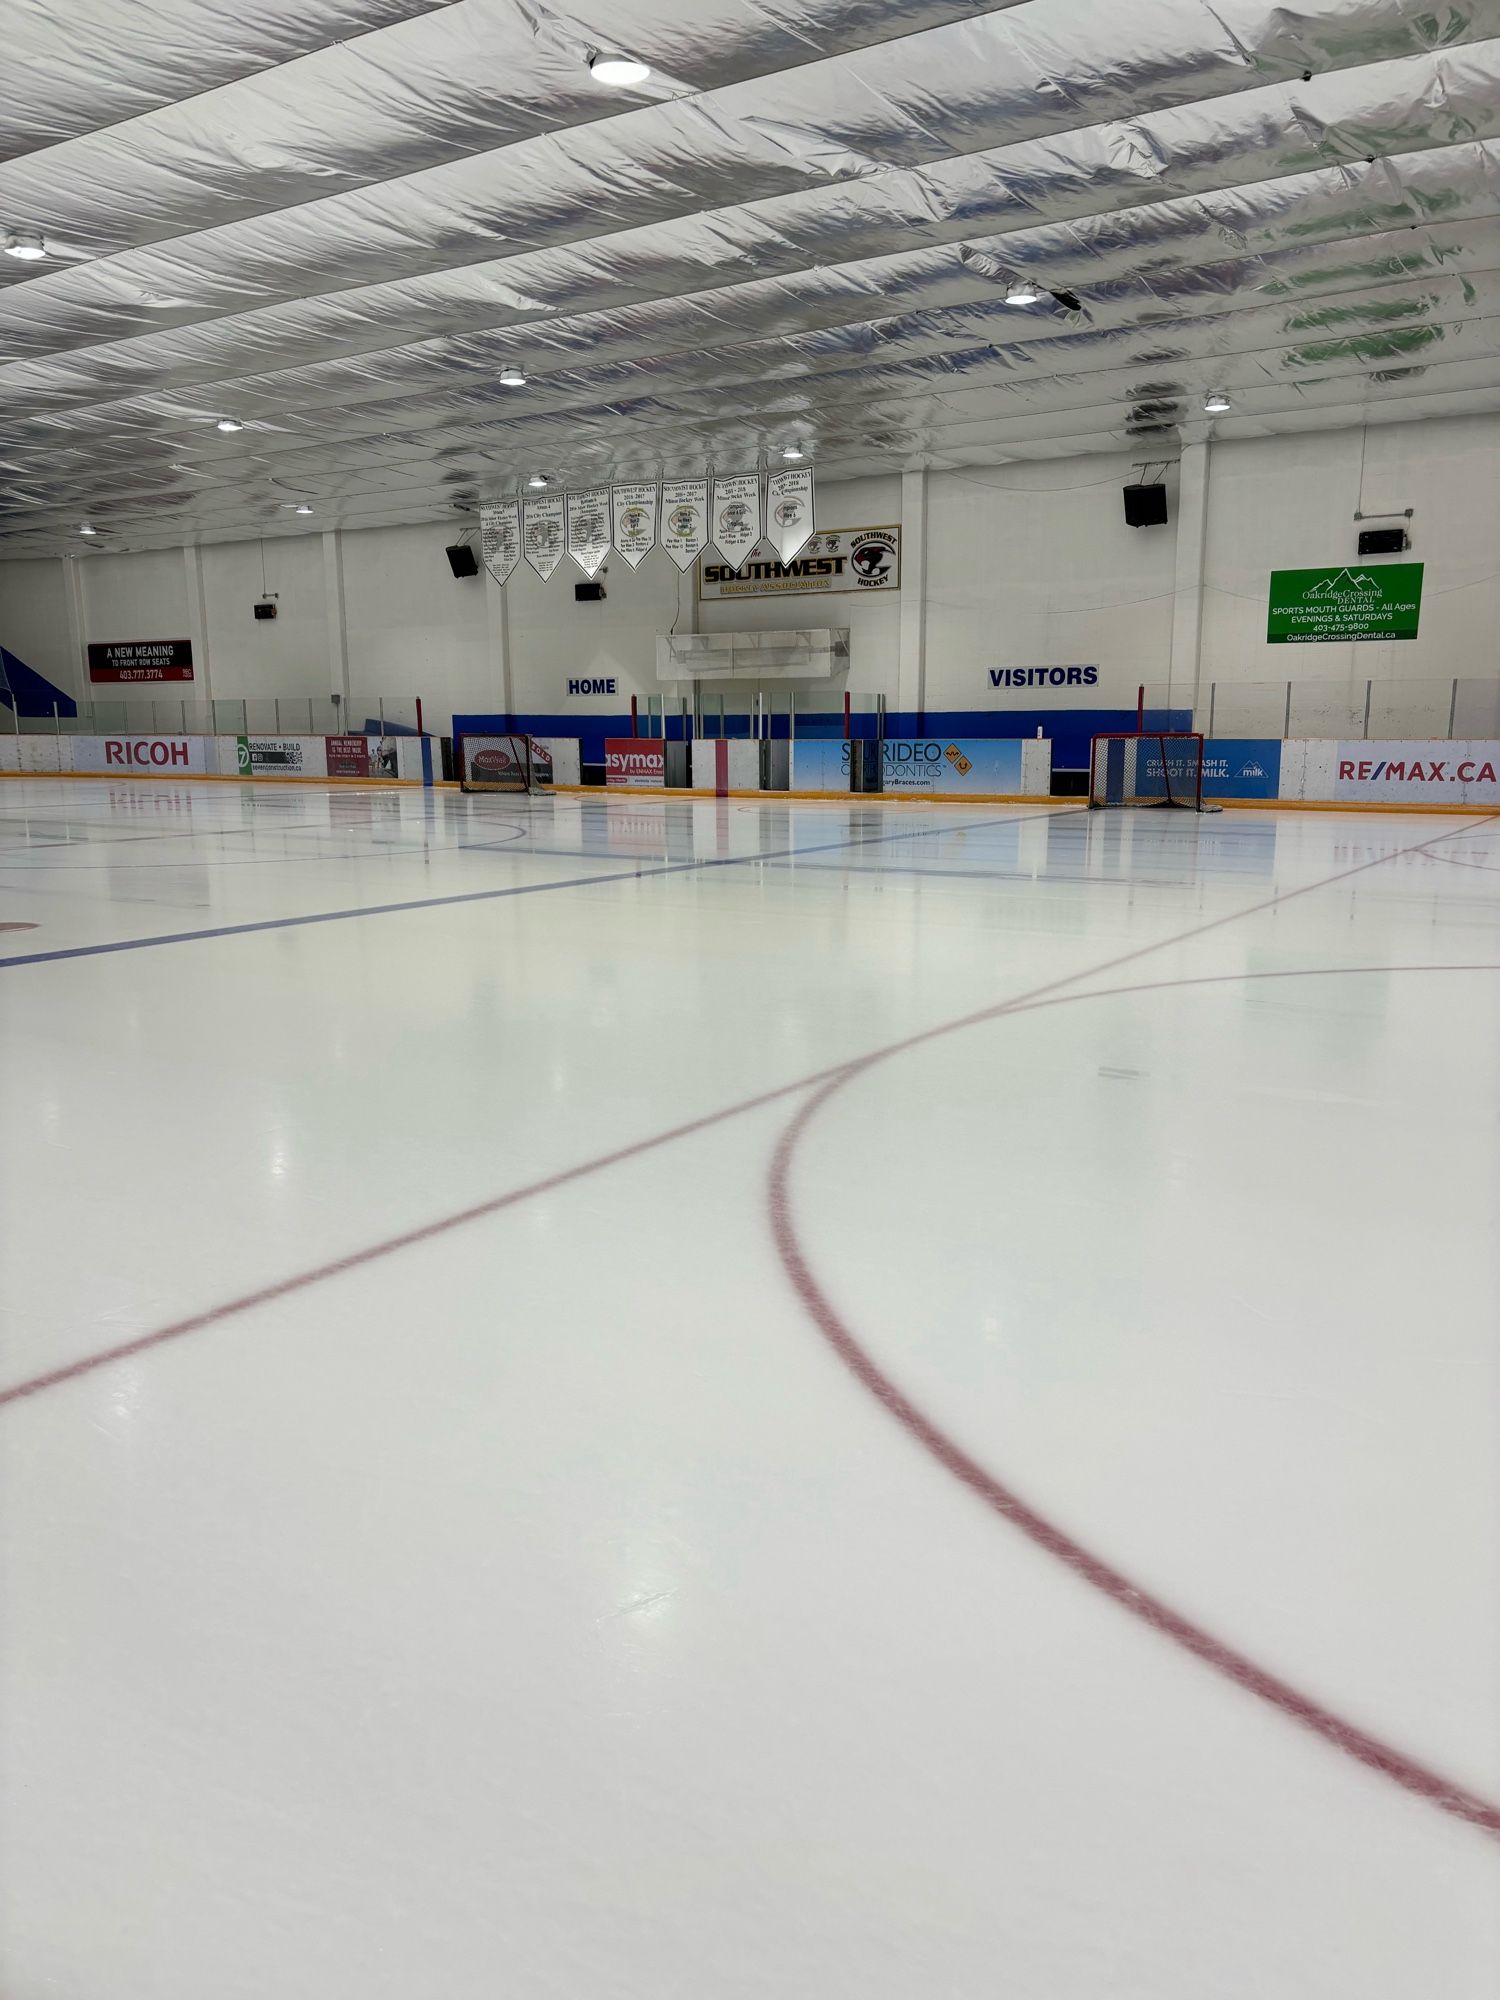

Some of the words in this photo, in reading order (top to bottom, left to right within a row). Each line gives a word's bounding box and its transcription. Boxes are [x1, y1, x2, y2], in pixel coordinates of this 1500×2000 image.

[850, 531, 897, 548] SOUTHWEST
[704, 557, 847, 583] SOUTHWEST
[857, 574, 889, 587] HOCKEY
[1272, 607, 1304, 615] SPORTS
[1305, 606, 1337, 614] MOUTH
[1339, 604, 1374, 612] GUARDS
[1382, 603, 1392, 611] All
[1394, 602, 1416, 612] Ages
[1343, 613, 1393, 621] SATURDAYS
[1313, 623, 1368, 631] 403-475-9800
[1287, 632, 1396, 642] OakridgeCrossingDental.ca
[107, 648, 113, 658] A
[115, 647, 133, 658] NEW
[135, 645, 174, 657] MEANING
[120, 669, 163, 680] 403.777.3774
[990, 666, 1098, 687] VISITORS
[569, 679, 616, 694] HOME
[105, 741, 189, 766] RICOH
[1202, 768, 1229, 778] MILK.
[1243, 766, 1263, 777] milk
[1339, 761, 1496, 782] RE/MAX.CA
